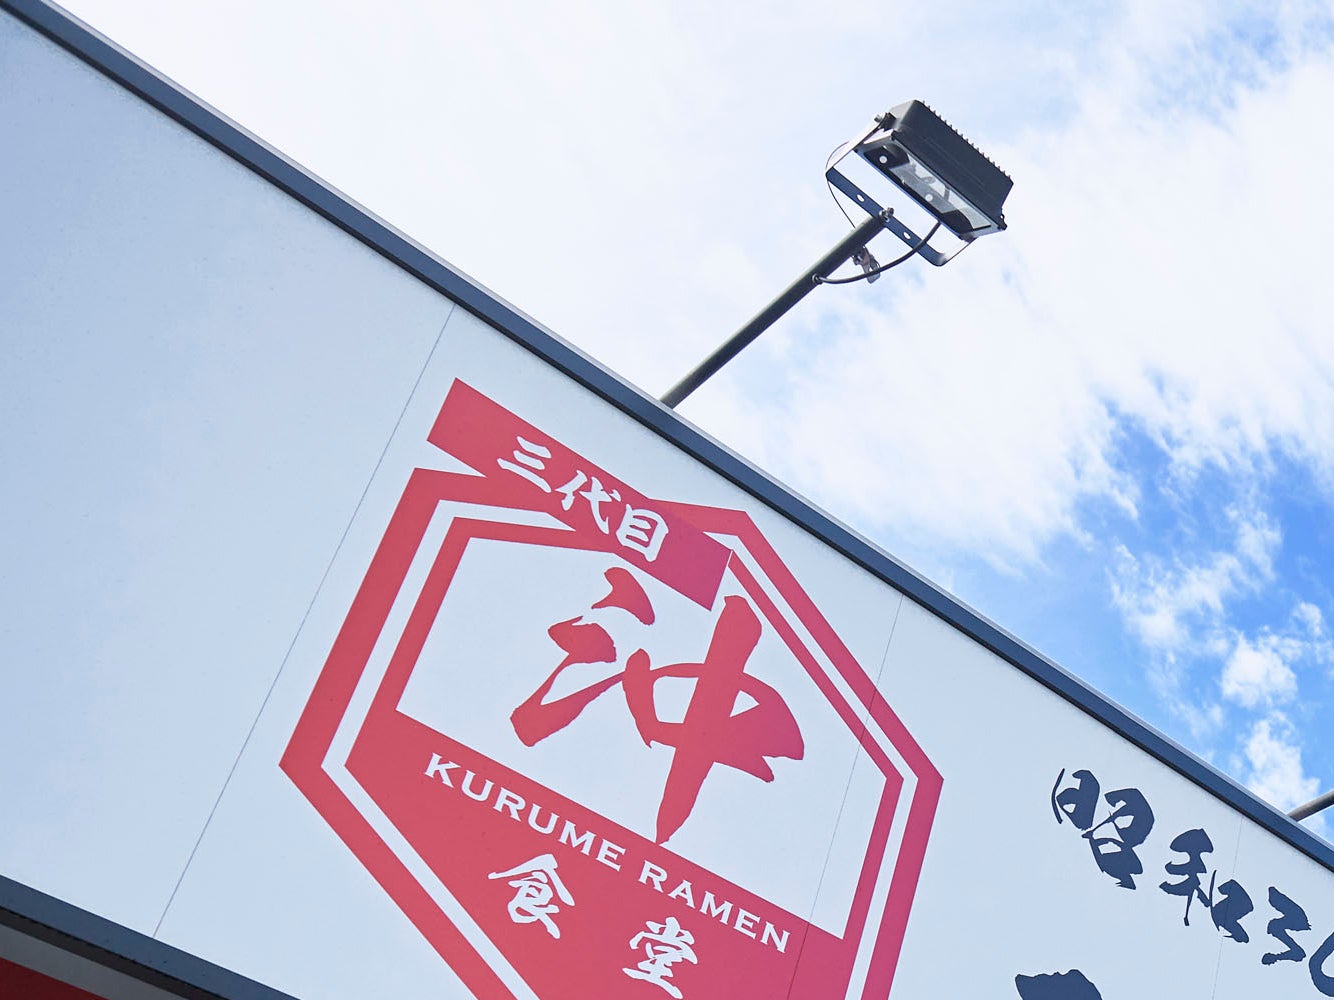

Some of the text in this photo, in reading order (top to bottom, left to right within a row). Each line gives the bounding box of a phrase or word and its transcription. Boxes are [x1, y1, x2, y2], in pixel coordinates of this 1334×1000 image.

[497, 435, 669, 562] 三代目
[509, 566, 805, 846] 沖
[424, 752, 790, 953] KURUME RAMEN
[488, 853, 698, 999] 食堂
